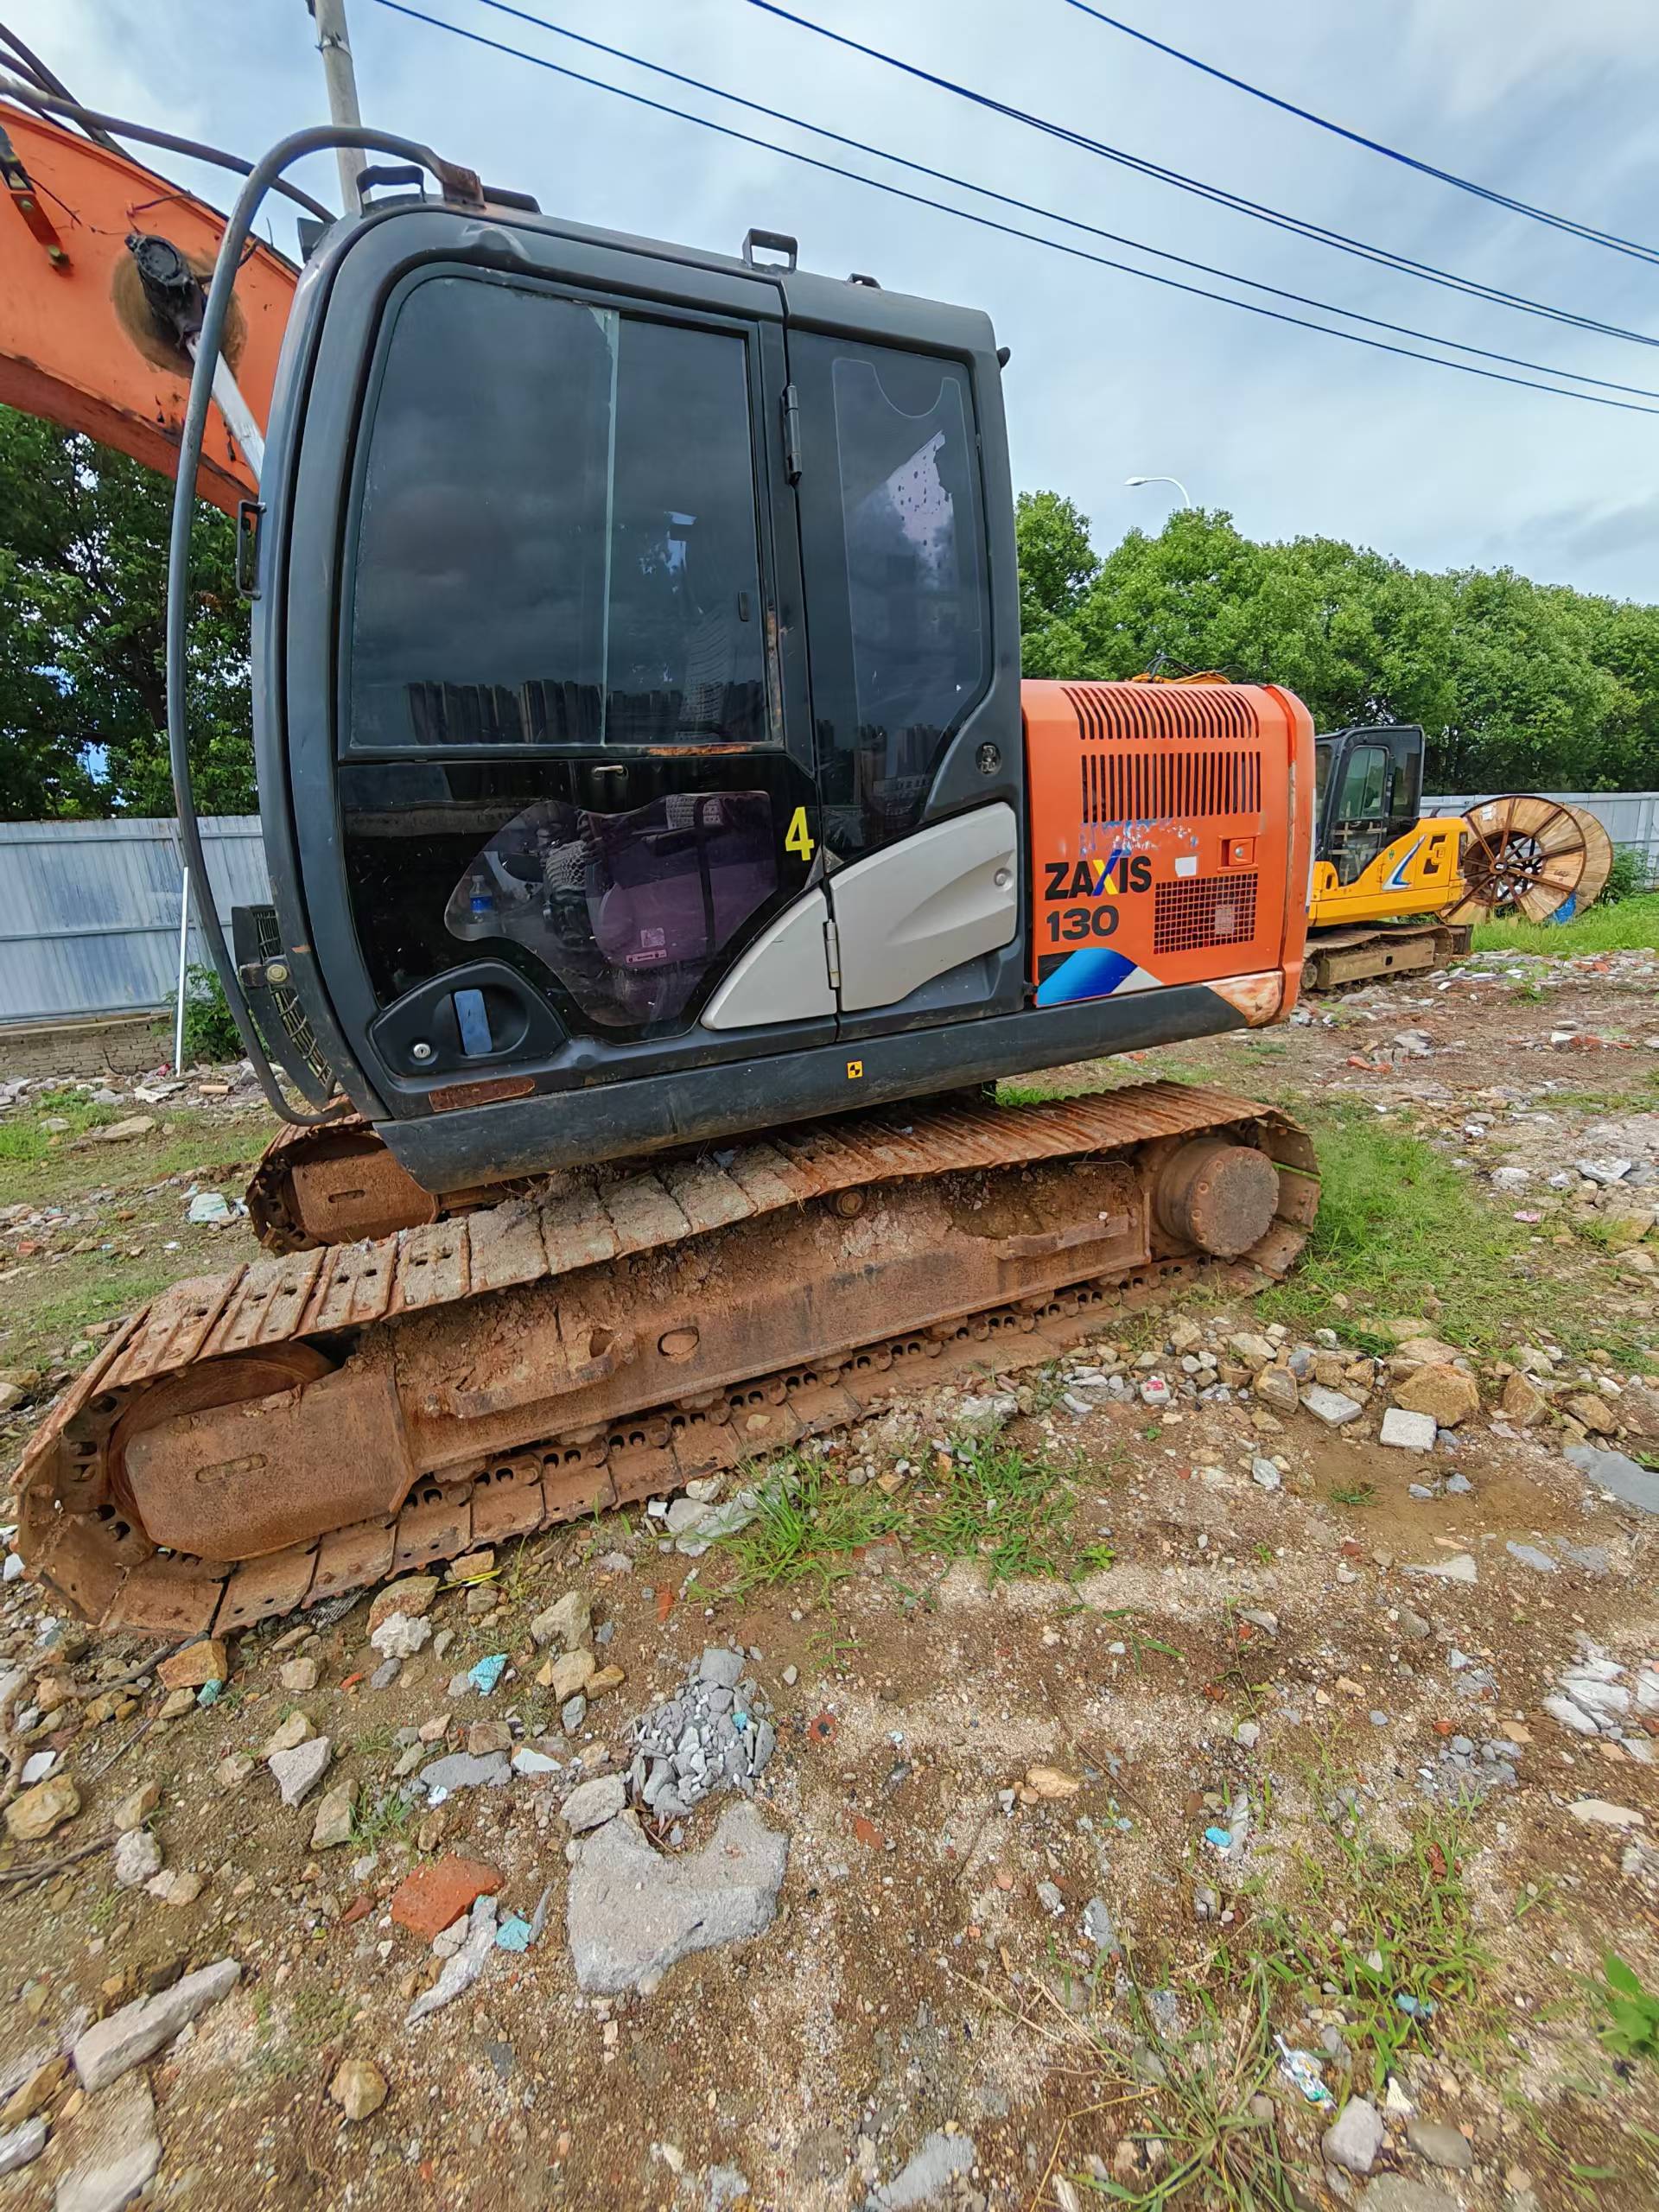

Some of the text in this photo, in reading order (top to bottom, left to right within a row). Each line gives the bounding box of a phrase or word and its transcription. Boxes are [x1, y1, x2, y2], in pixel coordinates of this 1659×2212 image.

[785, 806, 815, 861] 4
[1044, 849, 1153, 900] ZAXIS
[1046, 905, 1120, 942] 130
